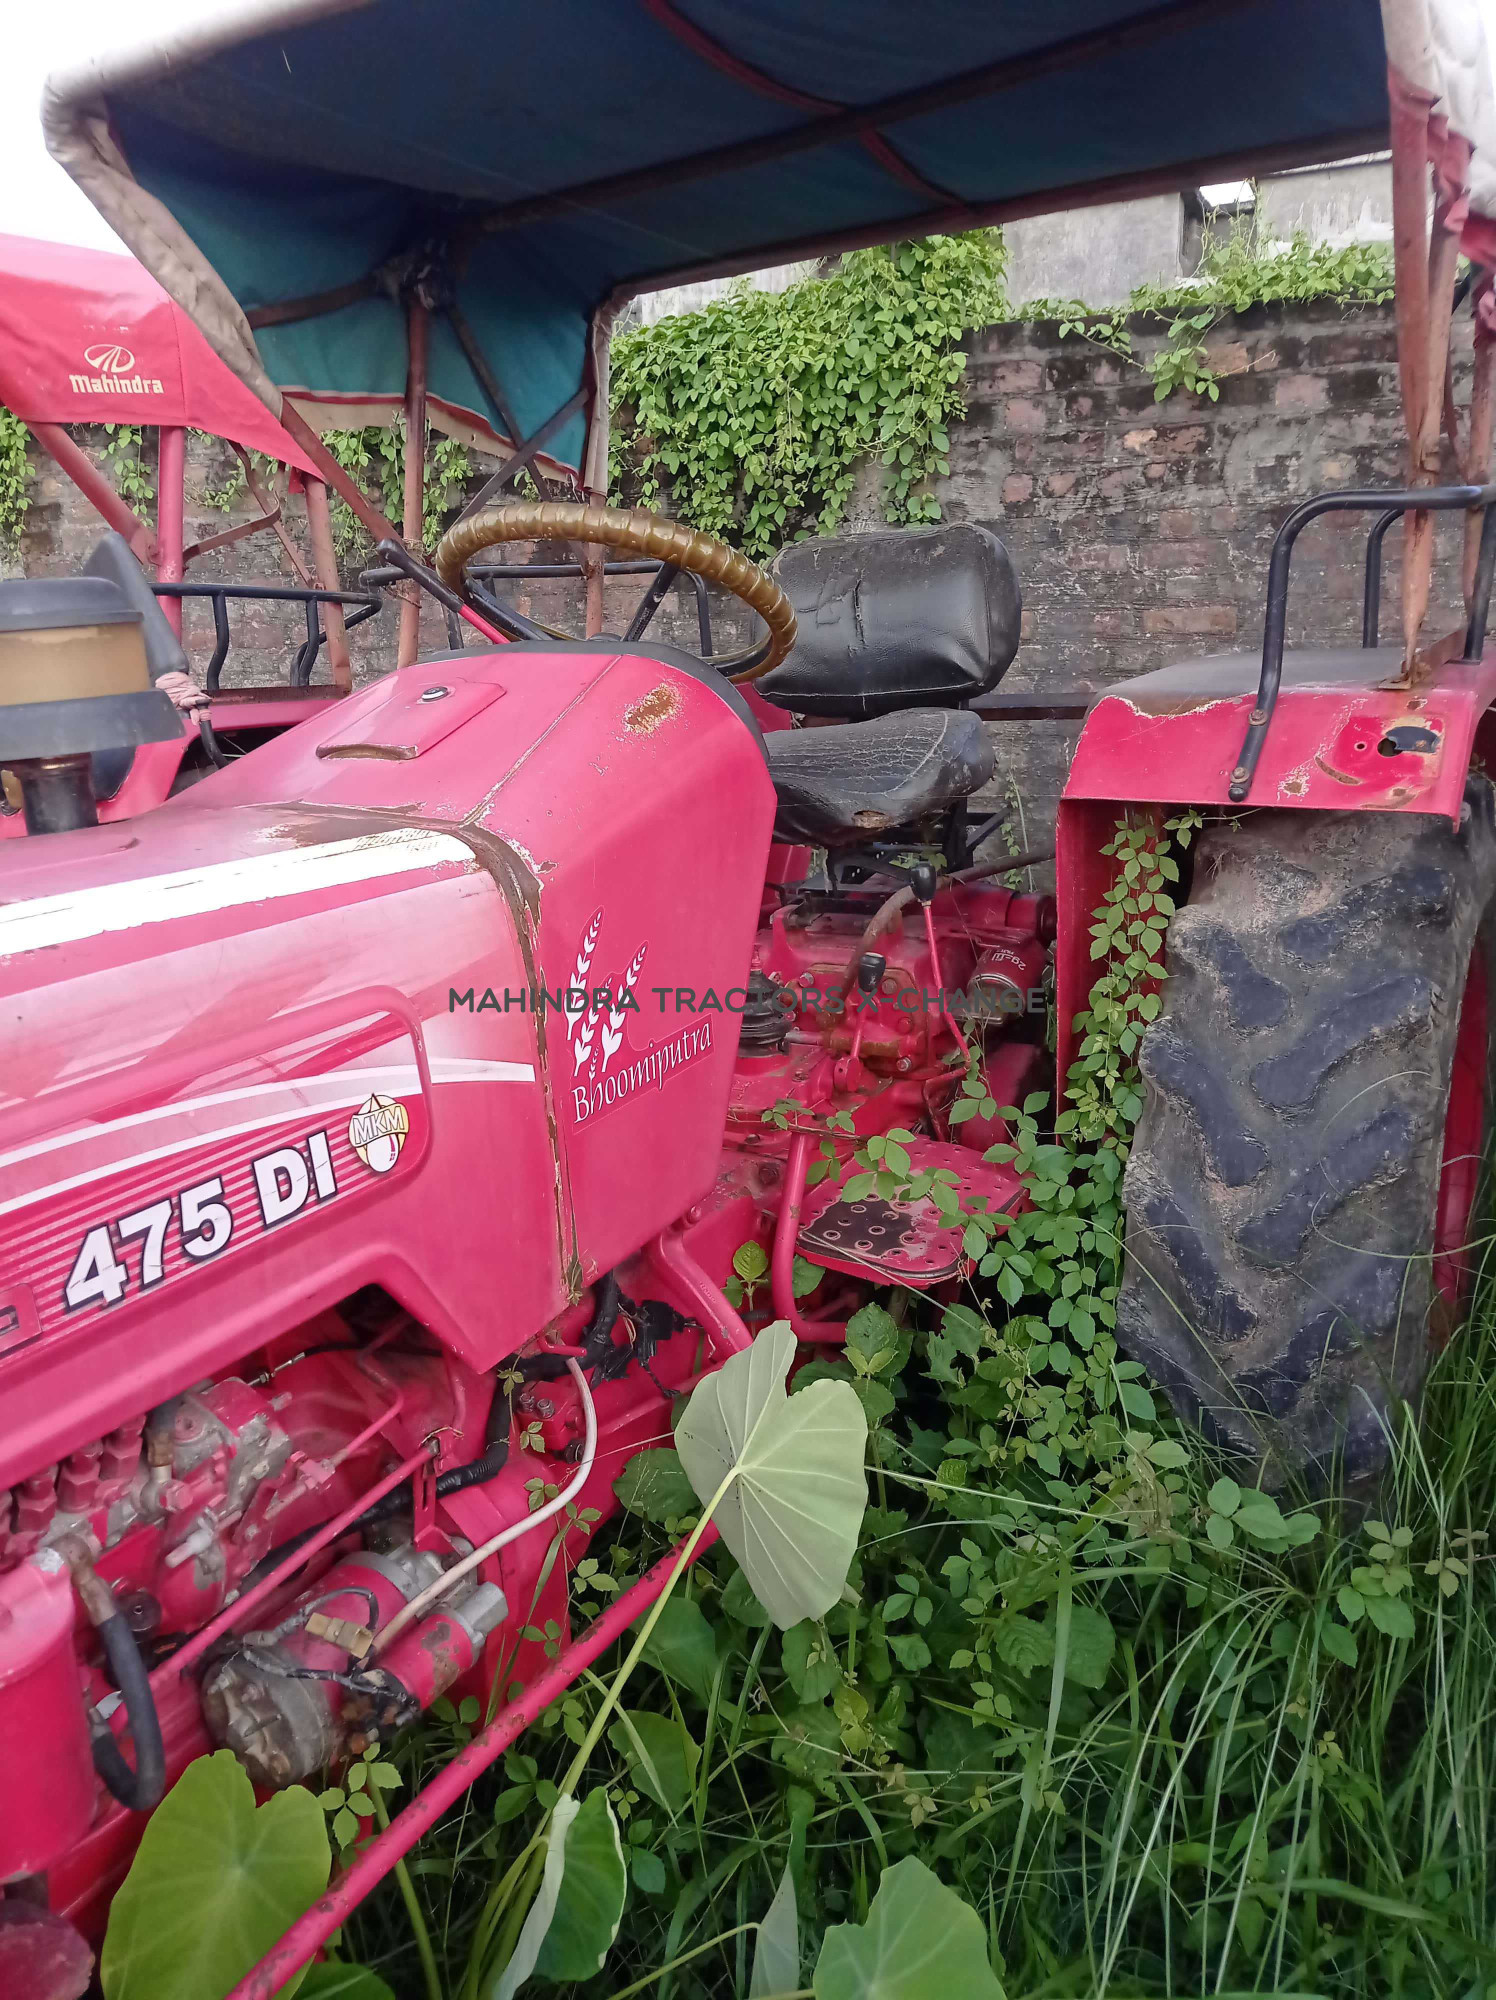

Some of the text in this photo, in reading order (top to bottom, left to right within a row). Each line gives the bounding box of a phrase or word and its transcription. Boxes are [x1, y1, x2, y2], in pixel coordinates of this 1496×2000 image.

[69, 374, 164, 394] Mahindra
[572, 1022, 712, 1124] Bhoomiputra
[353, 1105, 405, 1146] MKM
[65, 1129, 338, 1312] 475 DI
